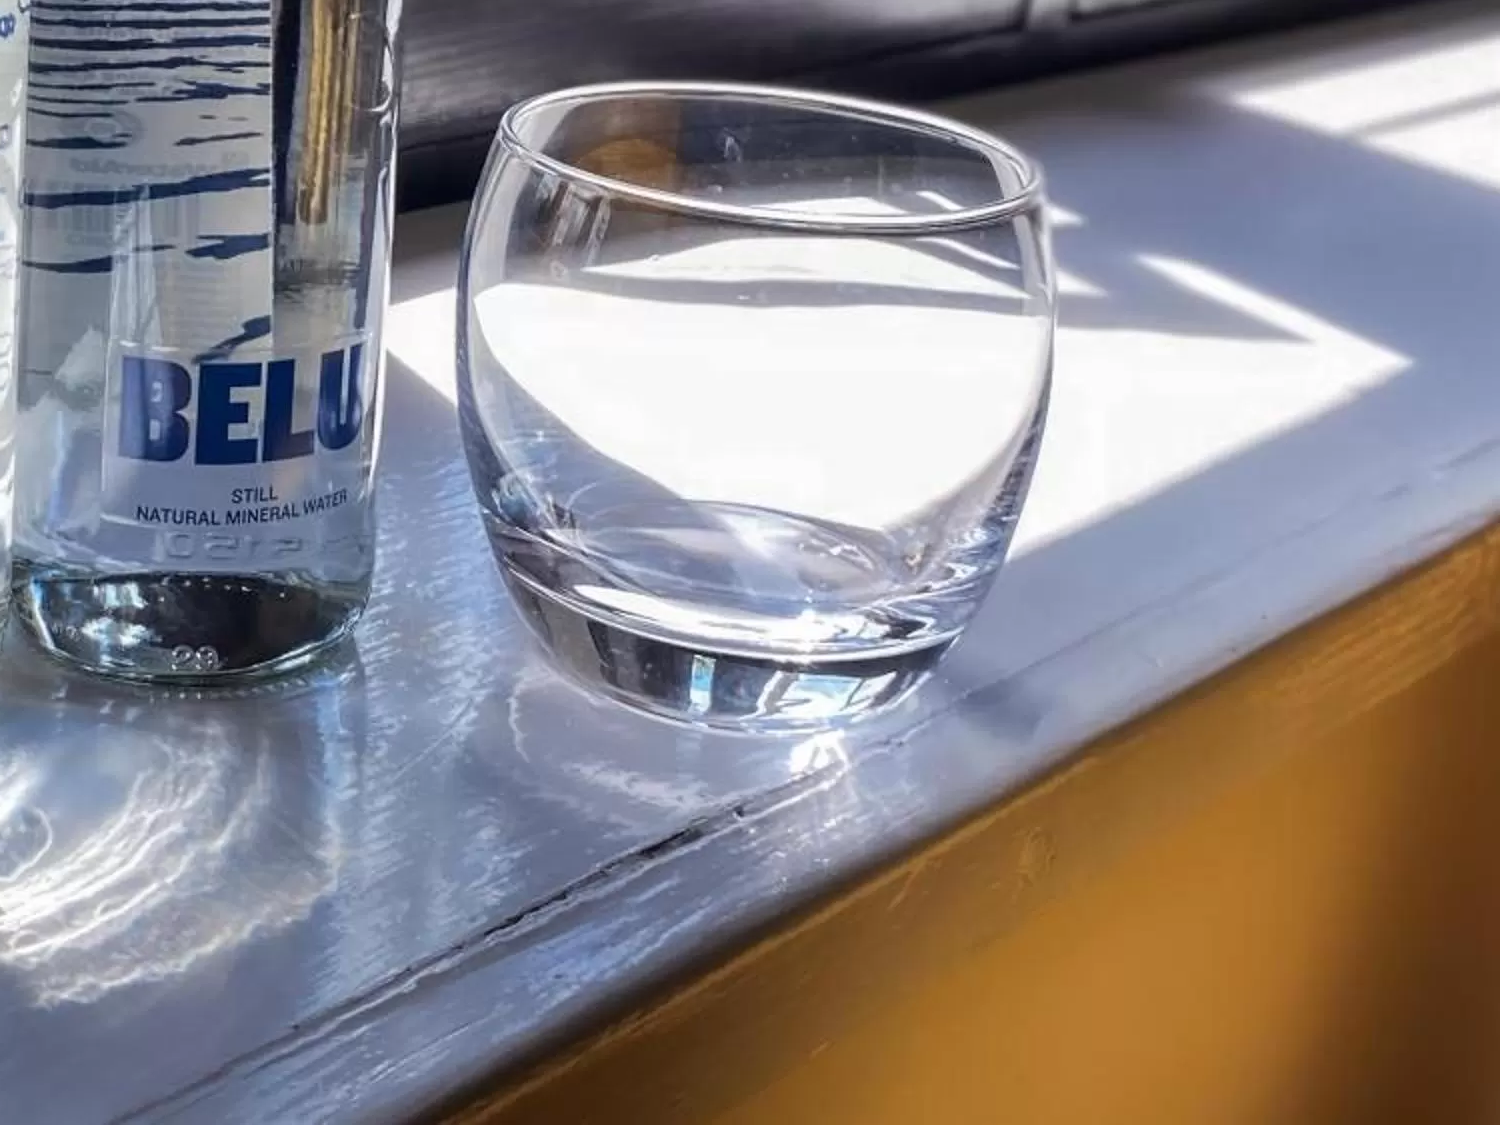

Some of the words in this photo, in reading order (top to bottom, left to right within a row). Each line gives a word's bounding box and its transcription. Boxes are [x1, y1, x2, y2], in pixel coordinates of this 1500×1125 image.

[118, 344, 363, 465] BELU
[135, 505, 221, 526] NATURAL
[224, 502, 300, 526] MINERAL
[302, 487, 348, 516] WATER
[231, 484, 279, 505] STILL
